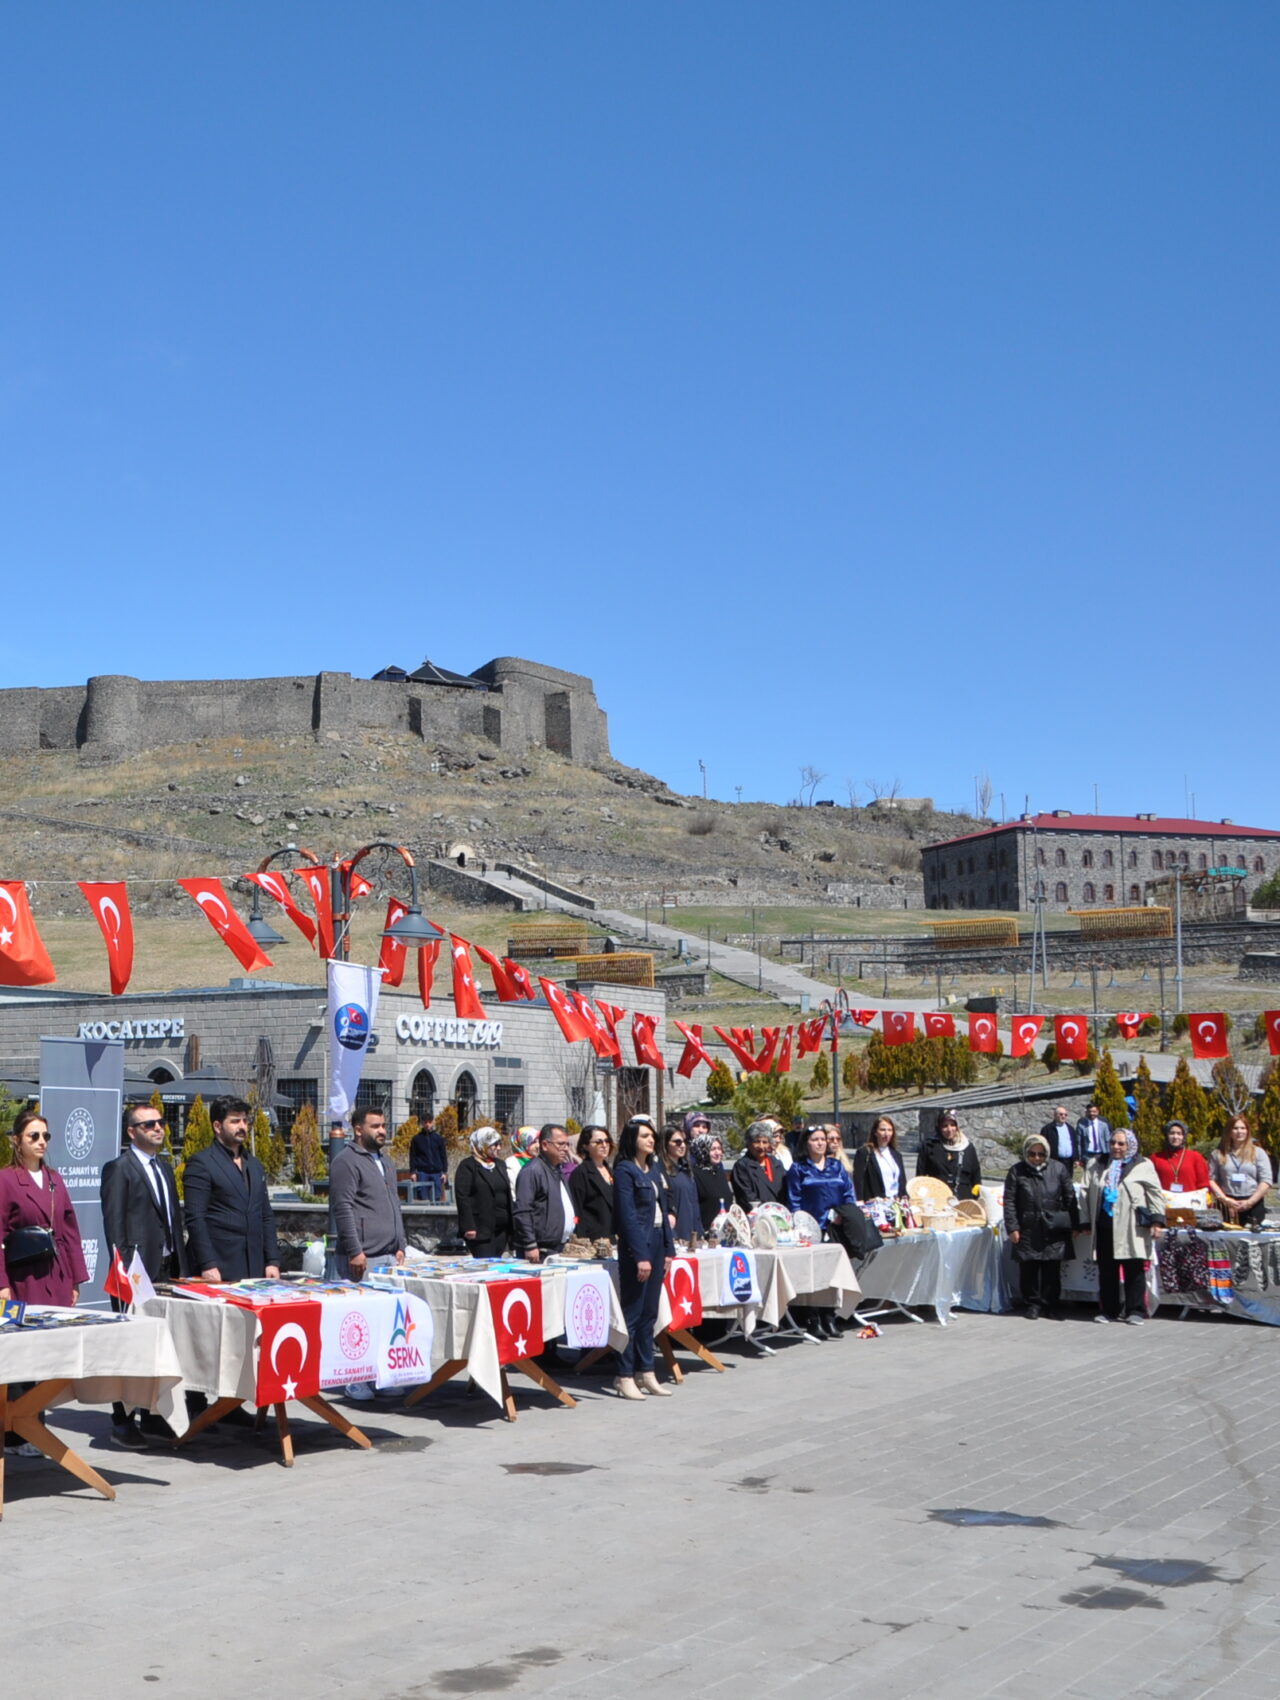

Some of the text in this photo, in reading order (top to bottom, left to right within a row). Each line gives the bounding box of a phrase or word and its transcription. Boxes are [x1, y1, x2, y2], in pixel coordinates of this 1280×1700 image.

[79, 1018, 185, 1040] KOCATEPE
[396, 1014, 469, 1043] COFFEE
[69, 1165, 90, 1176] SANAYİ
[91, 1166, 99, 1175] VE
[388, 1347, 424, 1370] SERKA
[345, 1366, 365, 1375] SANAYİ
[366, 1365, 373, 1373] VE
